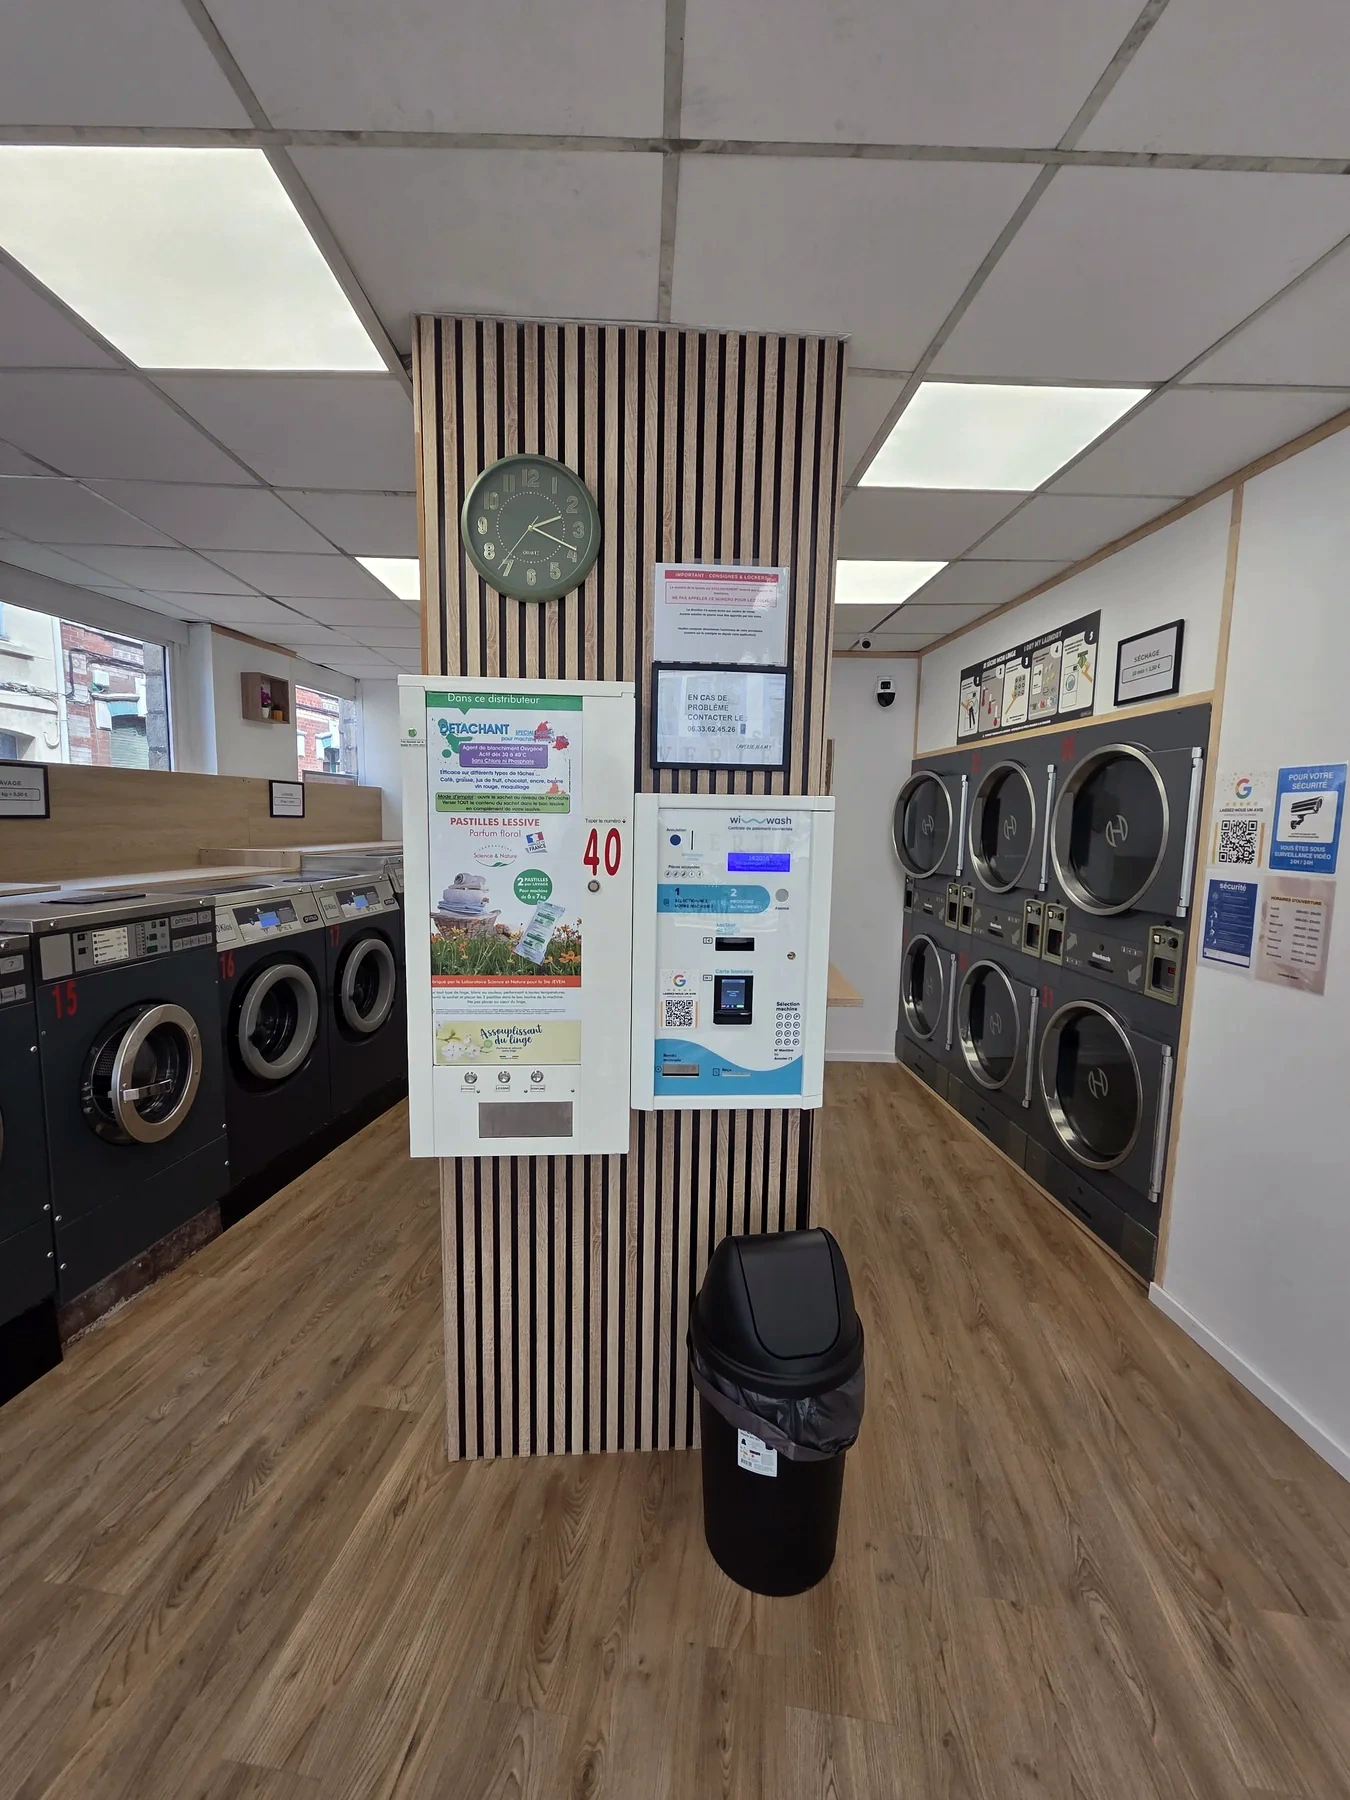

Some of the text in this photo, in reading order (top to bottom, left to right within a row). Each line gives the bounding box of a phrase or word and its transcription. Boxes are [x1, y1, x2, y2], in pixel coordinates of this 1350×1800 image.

[503, 474, 516, 492] 11
[522, 469, 540, 487] 12
[552, 477, 558, 494] 1
[484, 492, 499, 510] 10
[566, 496, 579, 513] 2
[478, 516, 488, 535] 9
[573, 521, 584, 538] 3
[484, 542, 495, 560] 8
[566, 546, 578, 562] 4
[502, 559, 515, 576] 7
[550, 562, 561, 580] 5
[527, 569, 536, 586] 6
[1134, 650, 1160, 662] SÉCHAGE
[448, 694, 472, 703] Dans
[488, 694, 540, 704] distributeur
[1288, 772, 1334, 781] POUR VOTRE
[1292, 780, 1328, 790] SÉCURITÉ
[450, 818, 540, 827] PASTILLES LESSIVE
[469, 829, 521, 838] Parfum floral
[583, 828, 621, 876] 40
[517, 877, 524, 886] 2
[1220, 882, 1247, 892] sécurité
[675, 888, 680, 896] 1
[730, 888, 737, 897] 2
[220, 951, 235, 979] 16
[52, 979, 77, 1019] 15
[480, 1024, 542, 1039] Assouplissant
[495, 1034, 532, 1046] du linge
